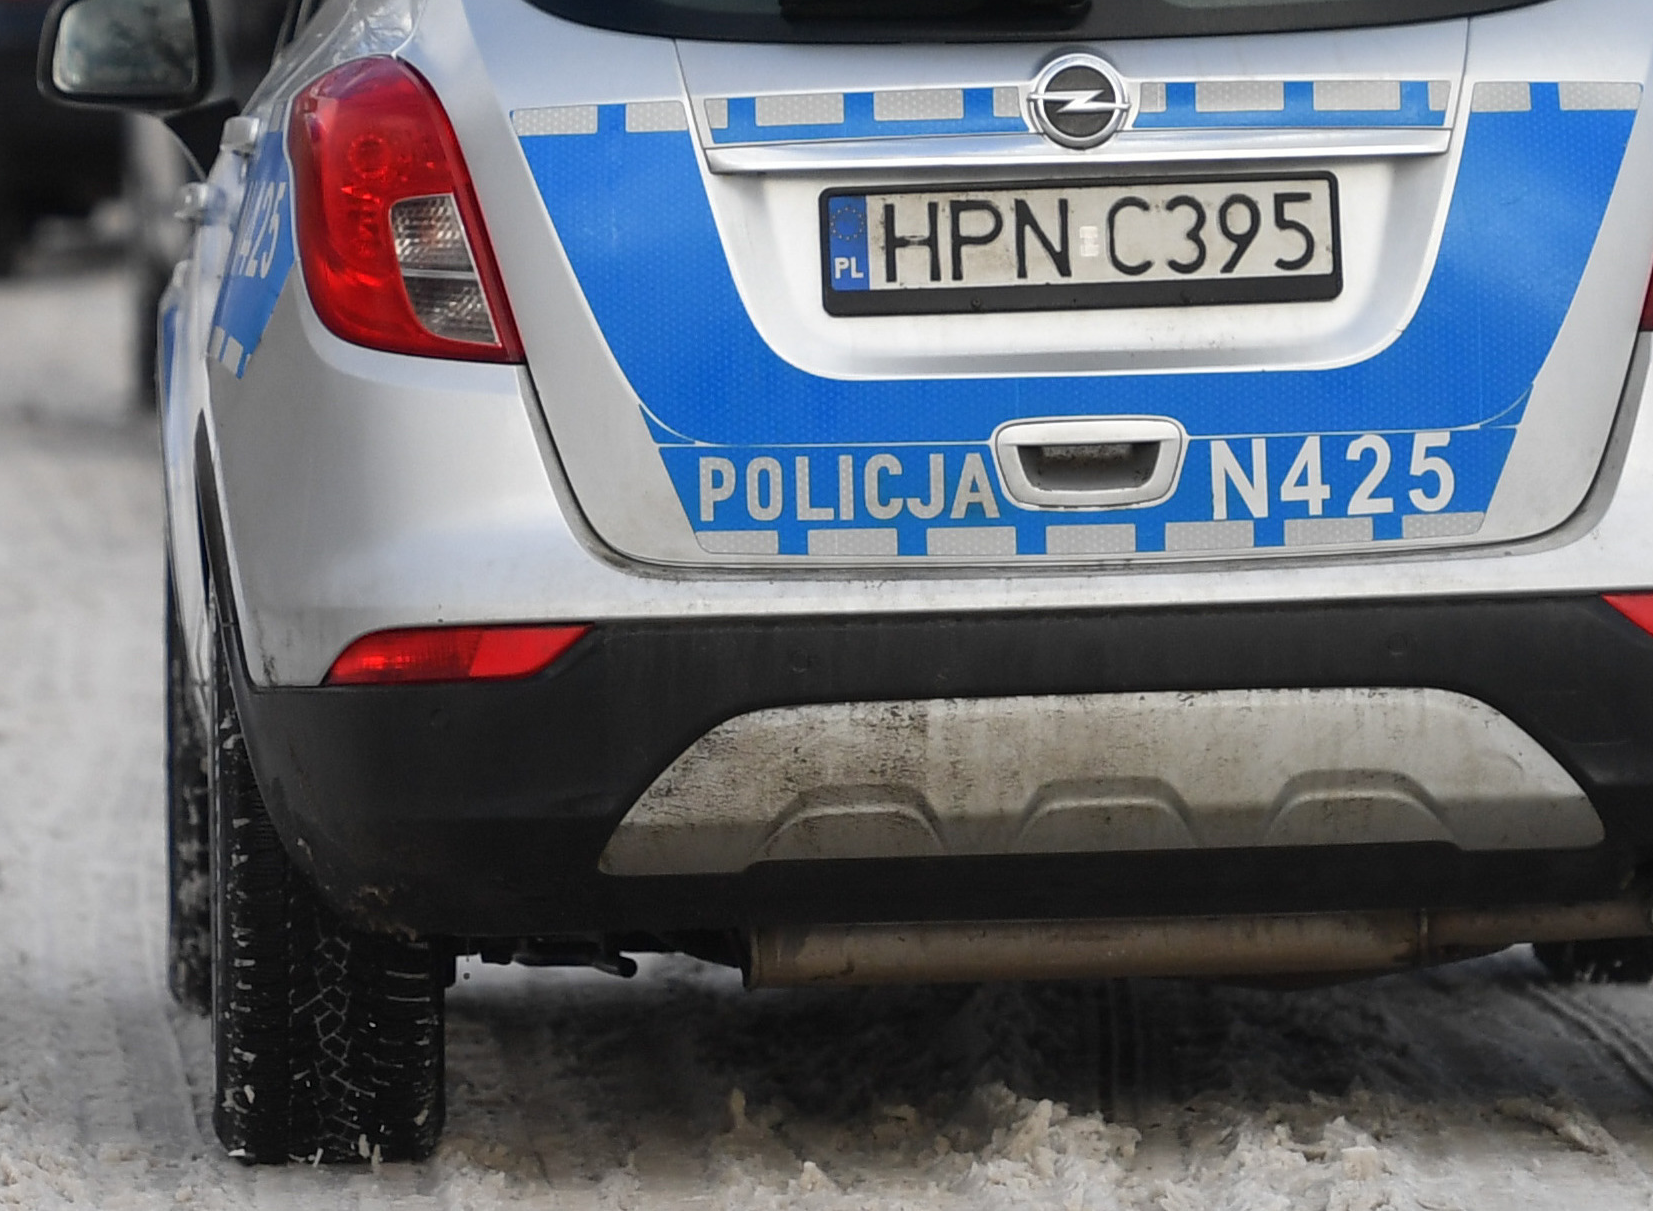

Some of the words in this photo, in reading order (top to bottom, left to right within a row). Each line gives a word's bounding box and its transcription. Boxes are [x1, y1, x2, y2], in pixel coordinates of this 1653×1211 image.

[834, 257, 864, 279] PL
[884, 198, 1072, 283] HPN
[1108, 192, 1316, 276] C395
[699, 452, 1000, 522] POLICJA
[1210, 431, 1455, 520] N425
